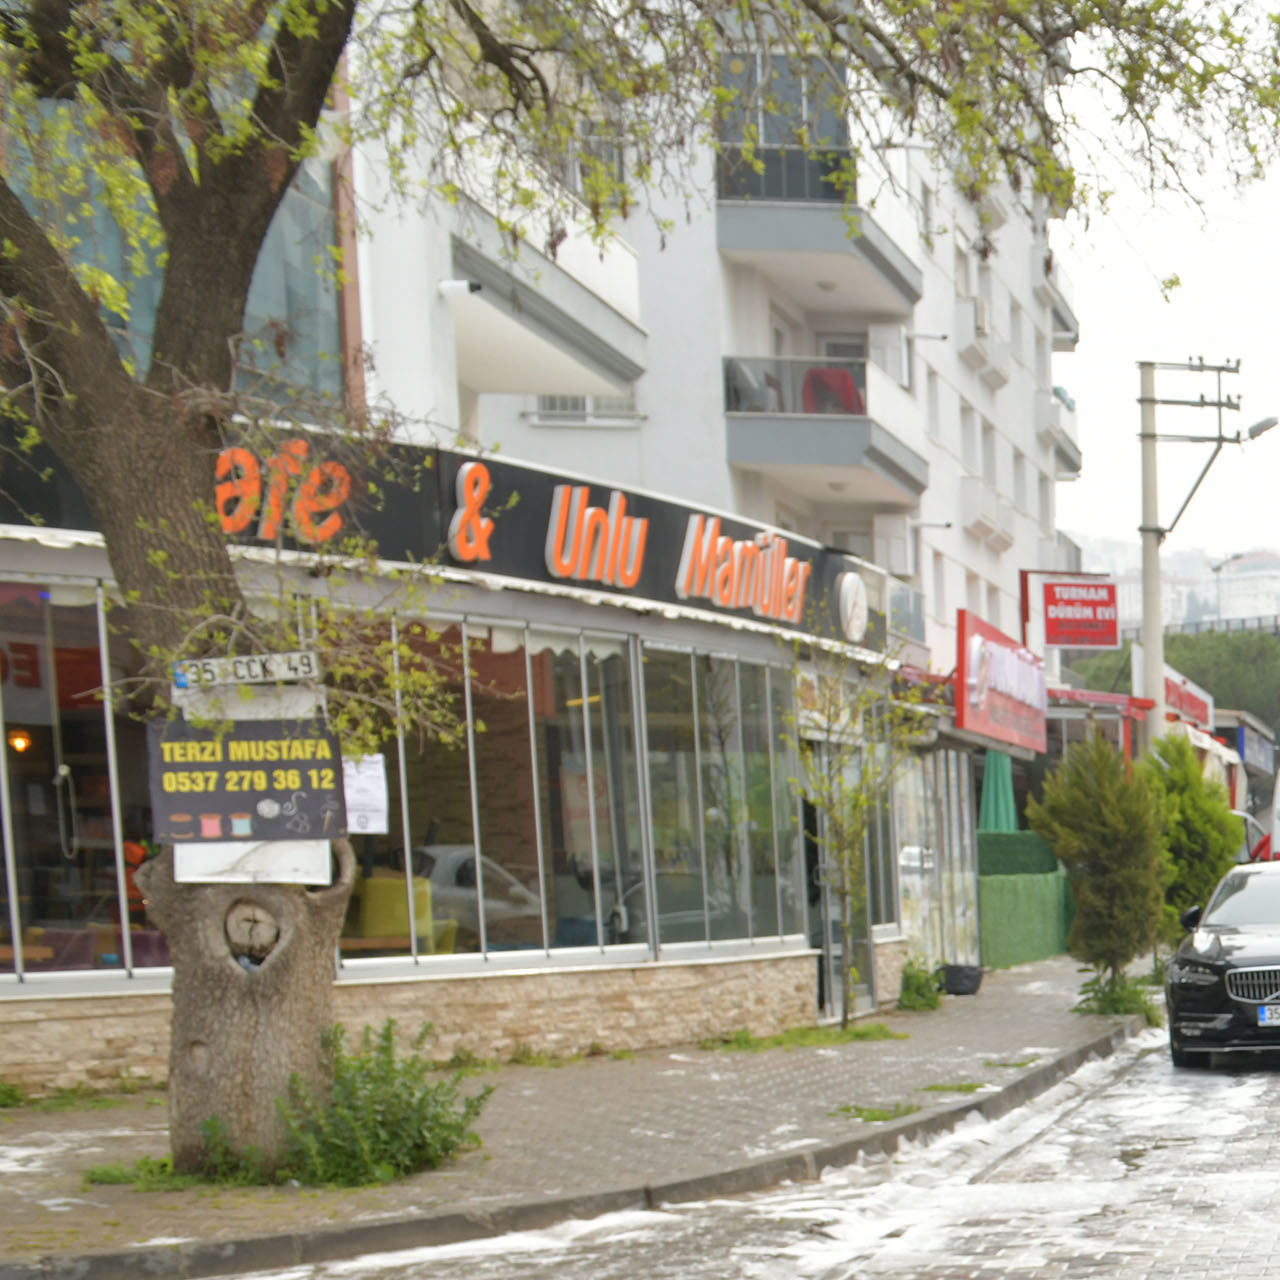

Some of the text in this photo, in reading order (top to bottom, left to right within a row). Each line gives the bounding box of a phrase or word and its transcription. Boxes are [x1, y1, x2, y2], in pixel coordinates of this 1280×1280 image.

[214, 438, 350, 543] afe
[449, 461, 495, 562] &
[545, 484, 649, 589] Unlu
[189, 654, 313, 683] 35 CCK 49
[228, 738, 332, 762] MUSTAFA
[162, 767, 336, 793] 0537 279 36 12
[1266, 1007, 1280, 1020] 35
